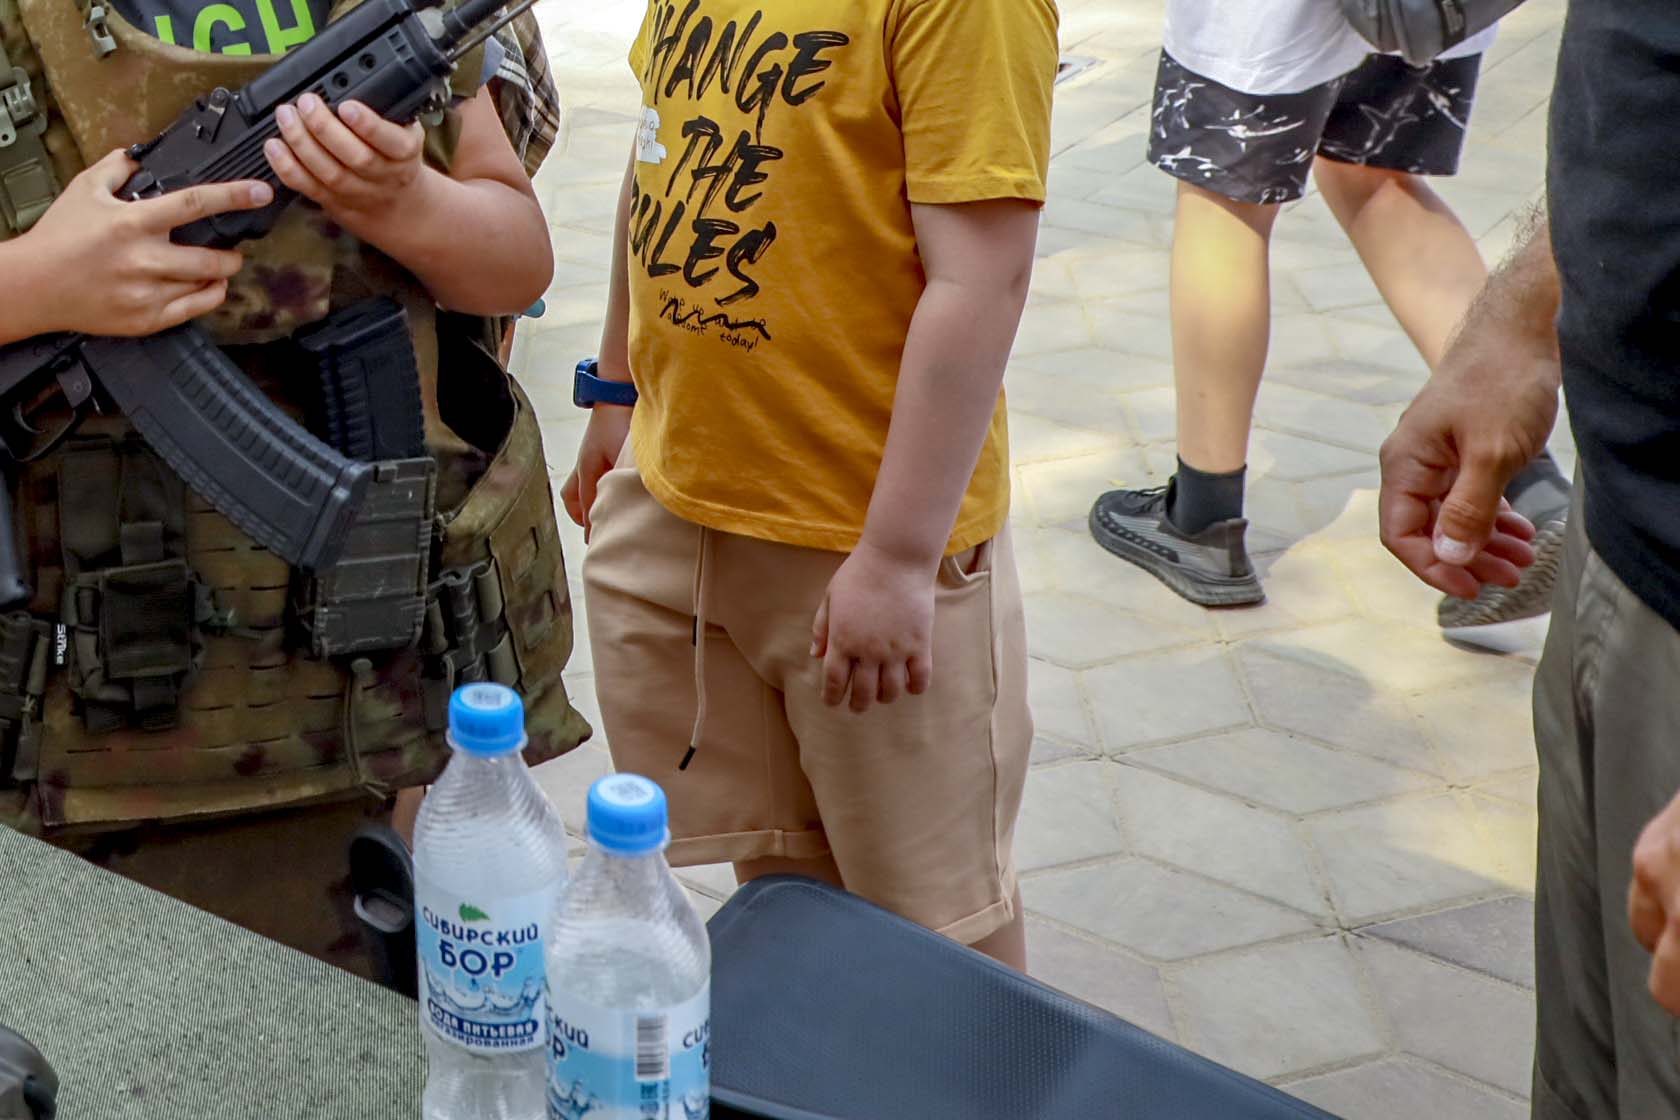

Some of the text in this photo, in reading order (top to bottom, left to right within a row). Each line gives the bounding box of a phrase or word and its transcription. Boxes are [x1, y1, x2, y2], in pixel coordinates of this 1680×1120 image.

[666, 115, 783, 221] THE
[720, 332, 760, 353] today!
[440, 939, 515, 978] БОР
